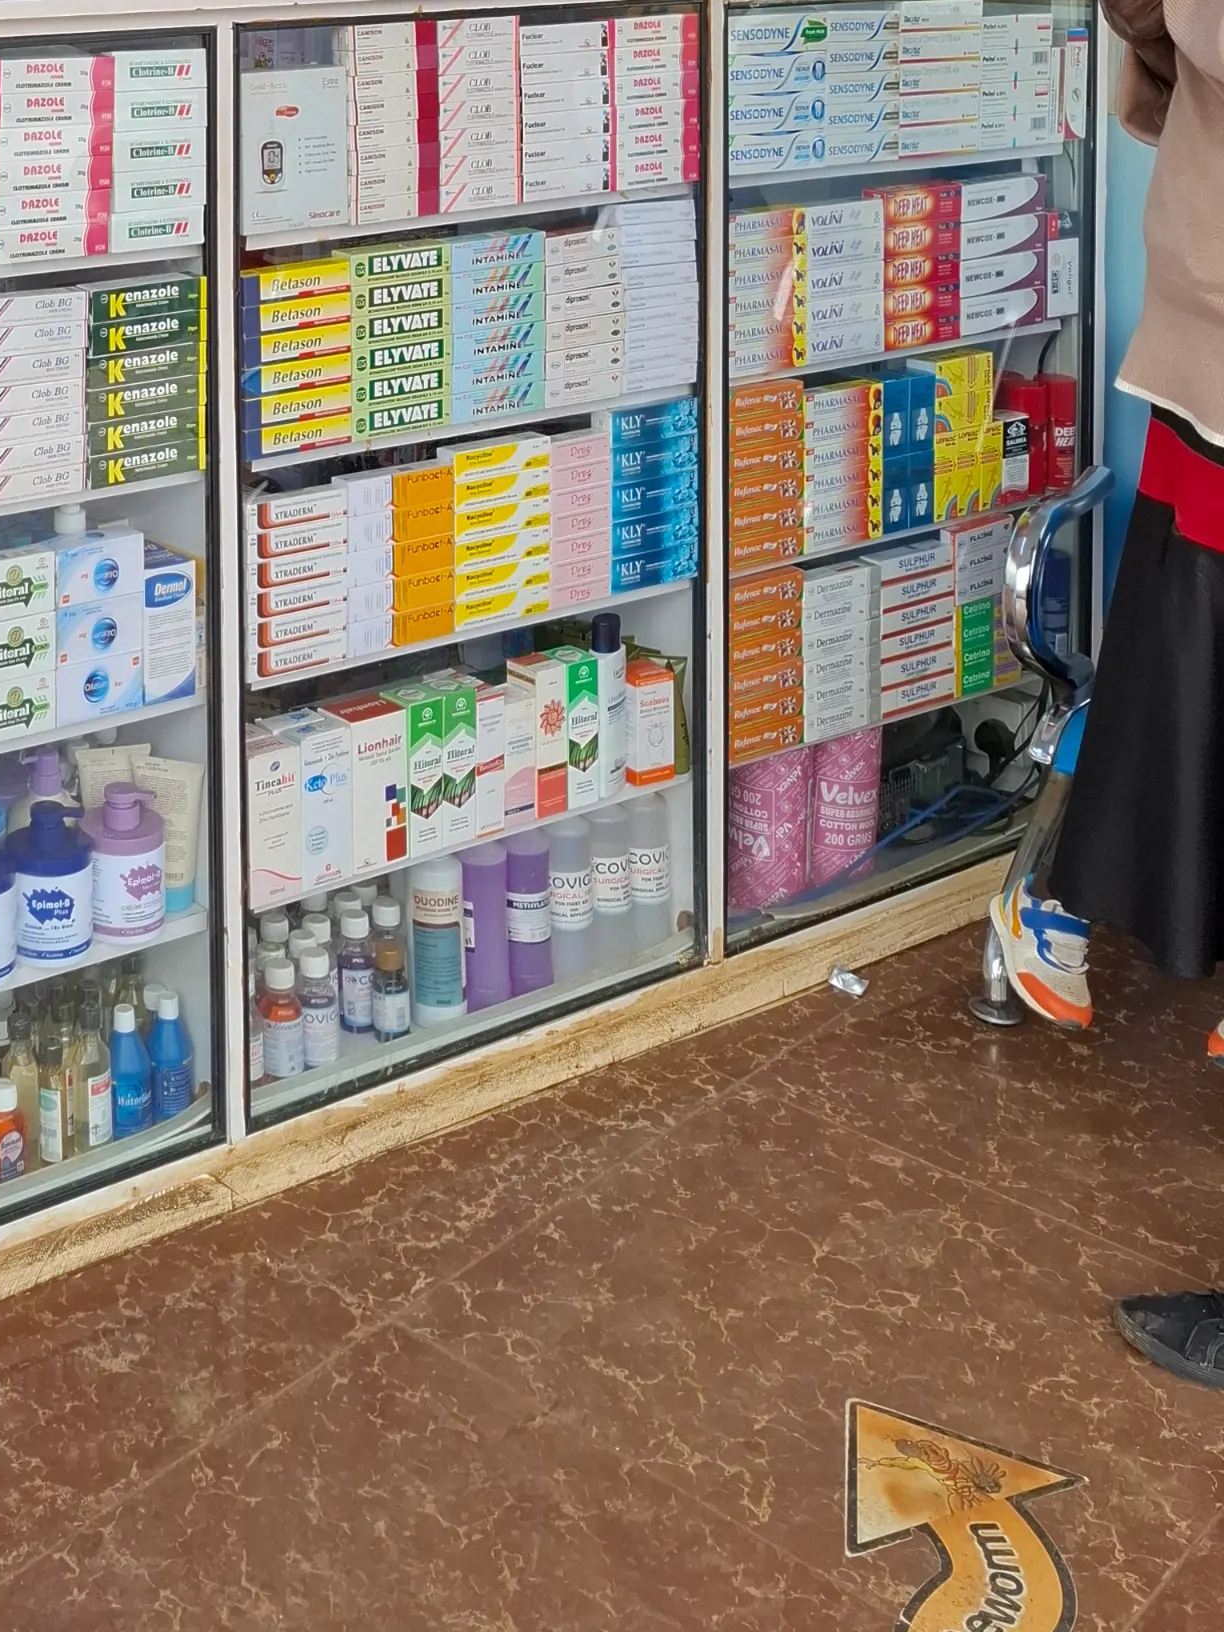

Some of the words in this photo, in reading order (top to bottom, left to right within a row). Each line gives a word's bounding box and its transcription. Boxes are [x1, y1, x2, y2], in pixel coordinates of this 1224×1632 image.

[522, 32, 544, 40] Fuclear
[730, 28, 790, 41] SENSODYNE
[26, 63, 65, 75] DAZOLE
[730, 68, 784, 81] SENSODYNE
[26, 96, 65, 109] DAZOLE
[308, 210, 340, 219] Sinocare
[892, 228, 910, 250] DEEP
[911, 226, 927, 246] HEAT
[373, 250, 438, 273] ELYVATE
[472, 252, 521, 265] INTAMINE
[271, 276, 321, 293] Betason
[35, 300, 53, 310] Clob
[54, 297, 73, 308] BG
[109, 286, 180, 317] Kenazole
[108, 319, 179, 351] Kenazole
[621, 415, 643, 430] KLY
[898, 553, 936, 569] SULPHUR
[154, 580, 187, 596] Dermol
[816, 578, 853, 595] Dermazine
[357, 734, 402, 755] Lionhair
[304, 775, 327, 792] Keto
[329, 773, 348, 786] Plus
[820, 782, 877, 806] Velvex
[819, 820, 858, 830] COTTON
[825, 833, 844, 846] 200
[847, 832, 872, 846] GRMS
[414, 895, 459, 908] DUODINE
